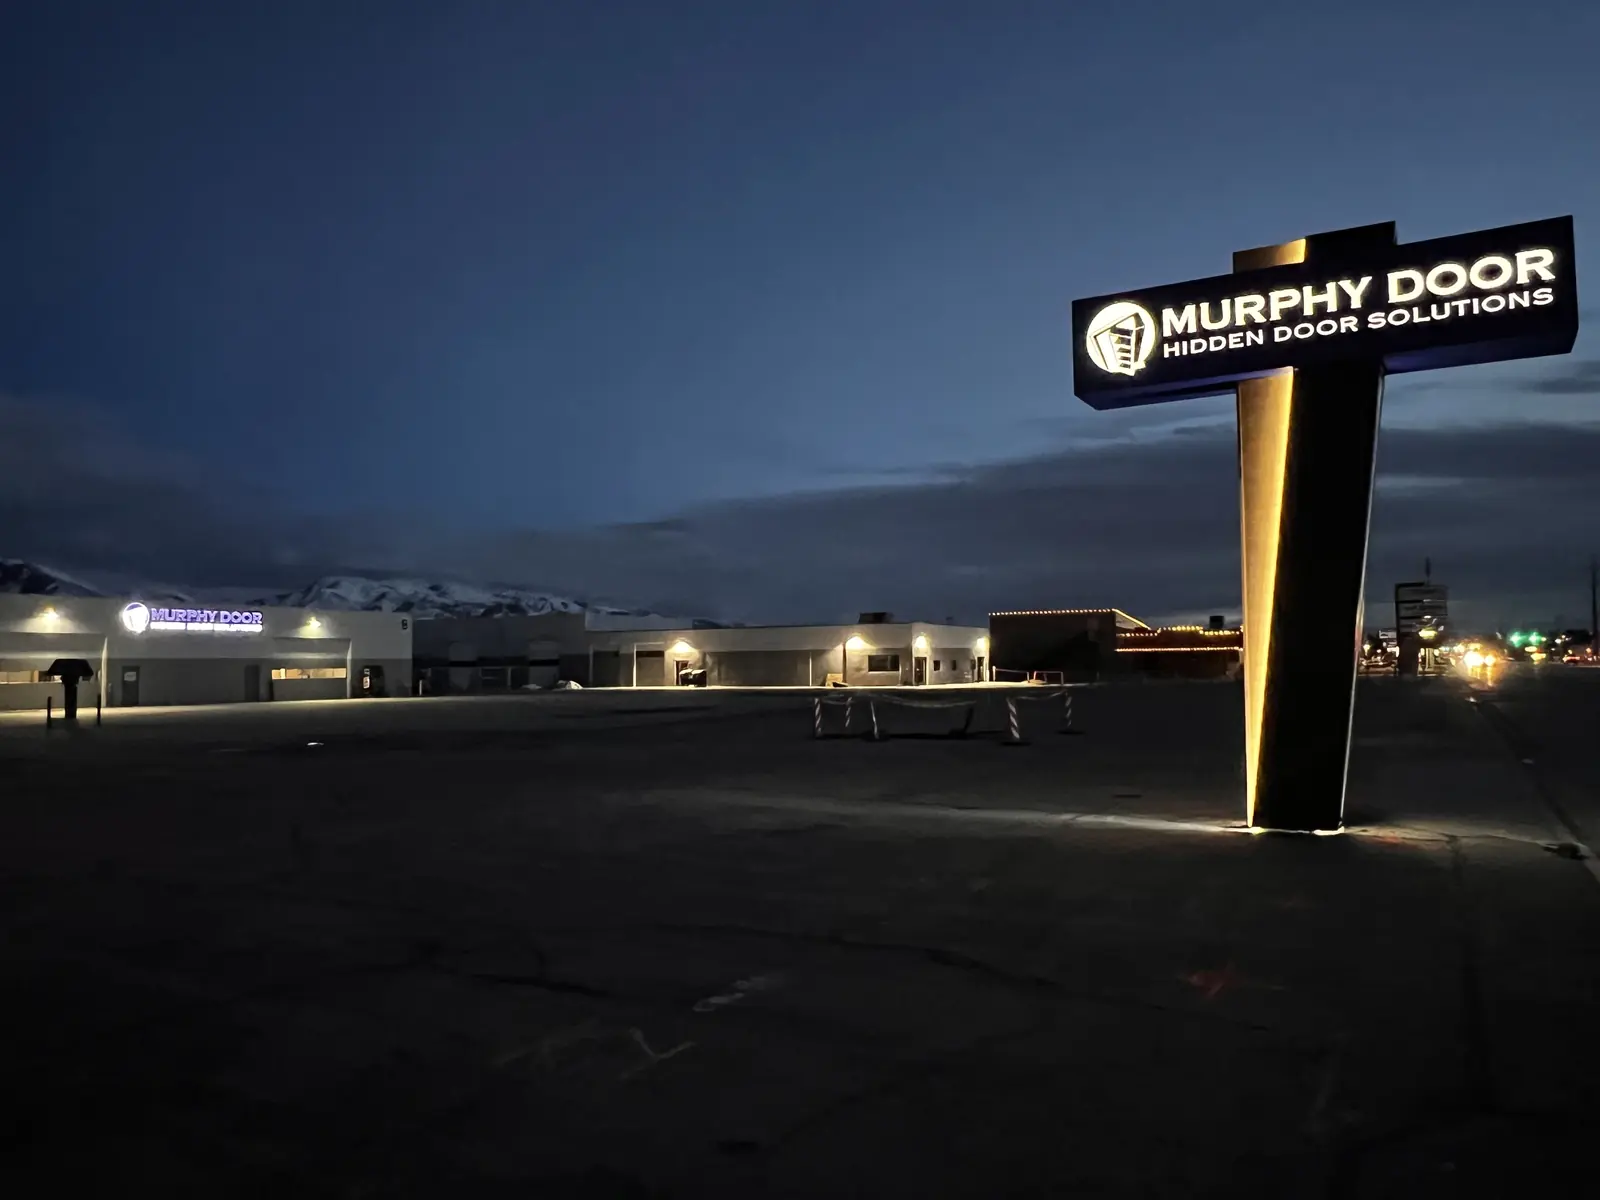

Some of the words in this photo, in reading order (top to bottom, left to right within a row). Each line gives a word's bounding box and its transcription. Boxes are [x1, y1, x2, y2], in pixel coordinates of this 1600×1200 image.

[1162, 276, 1372, 337] MURPHY
[1386, 249, 1555, 303] DOOR
[1163, 330, 1264, 359] HIDDEN
[1273, 316, 1360, 343] DOOR
[1367, 288, 1554, 328] SOLUTIONS
[151, 608, 216, 622] MURPHY
[220, 611, 263, 624] DOOR
